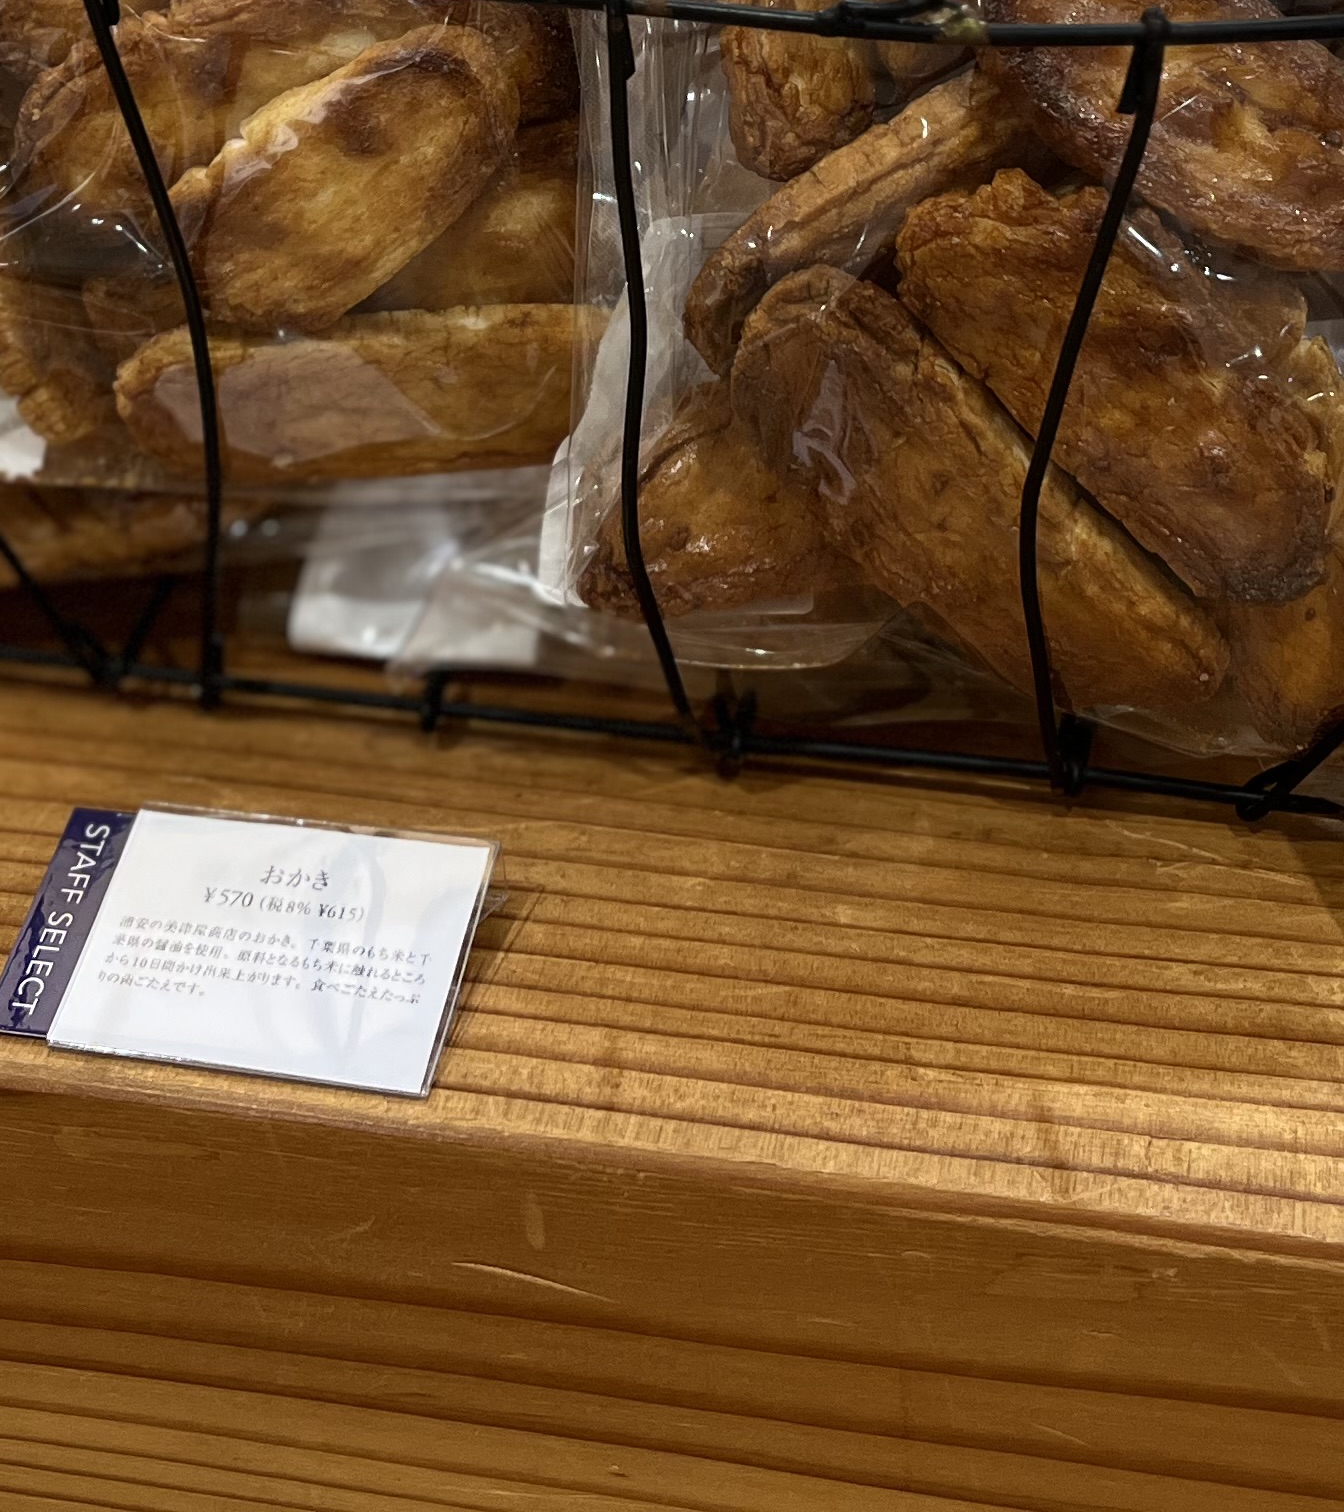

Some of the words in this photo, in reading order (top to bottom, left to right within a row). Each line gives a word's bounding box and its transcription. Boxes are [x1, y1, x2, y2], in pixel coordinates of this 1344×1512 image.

[61, 823, 110, 904] STAFF
[260, 865, 330, 891] おかき
[203, 887, 254, 908] ¥570
[11, 911, 74, 1016] SELECT
